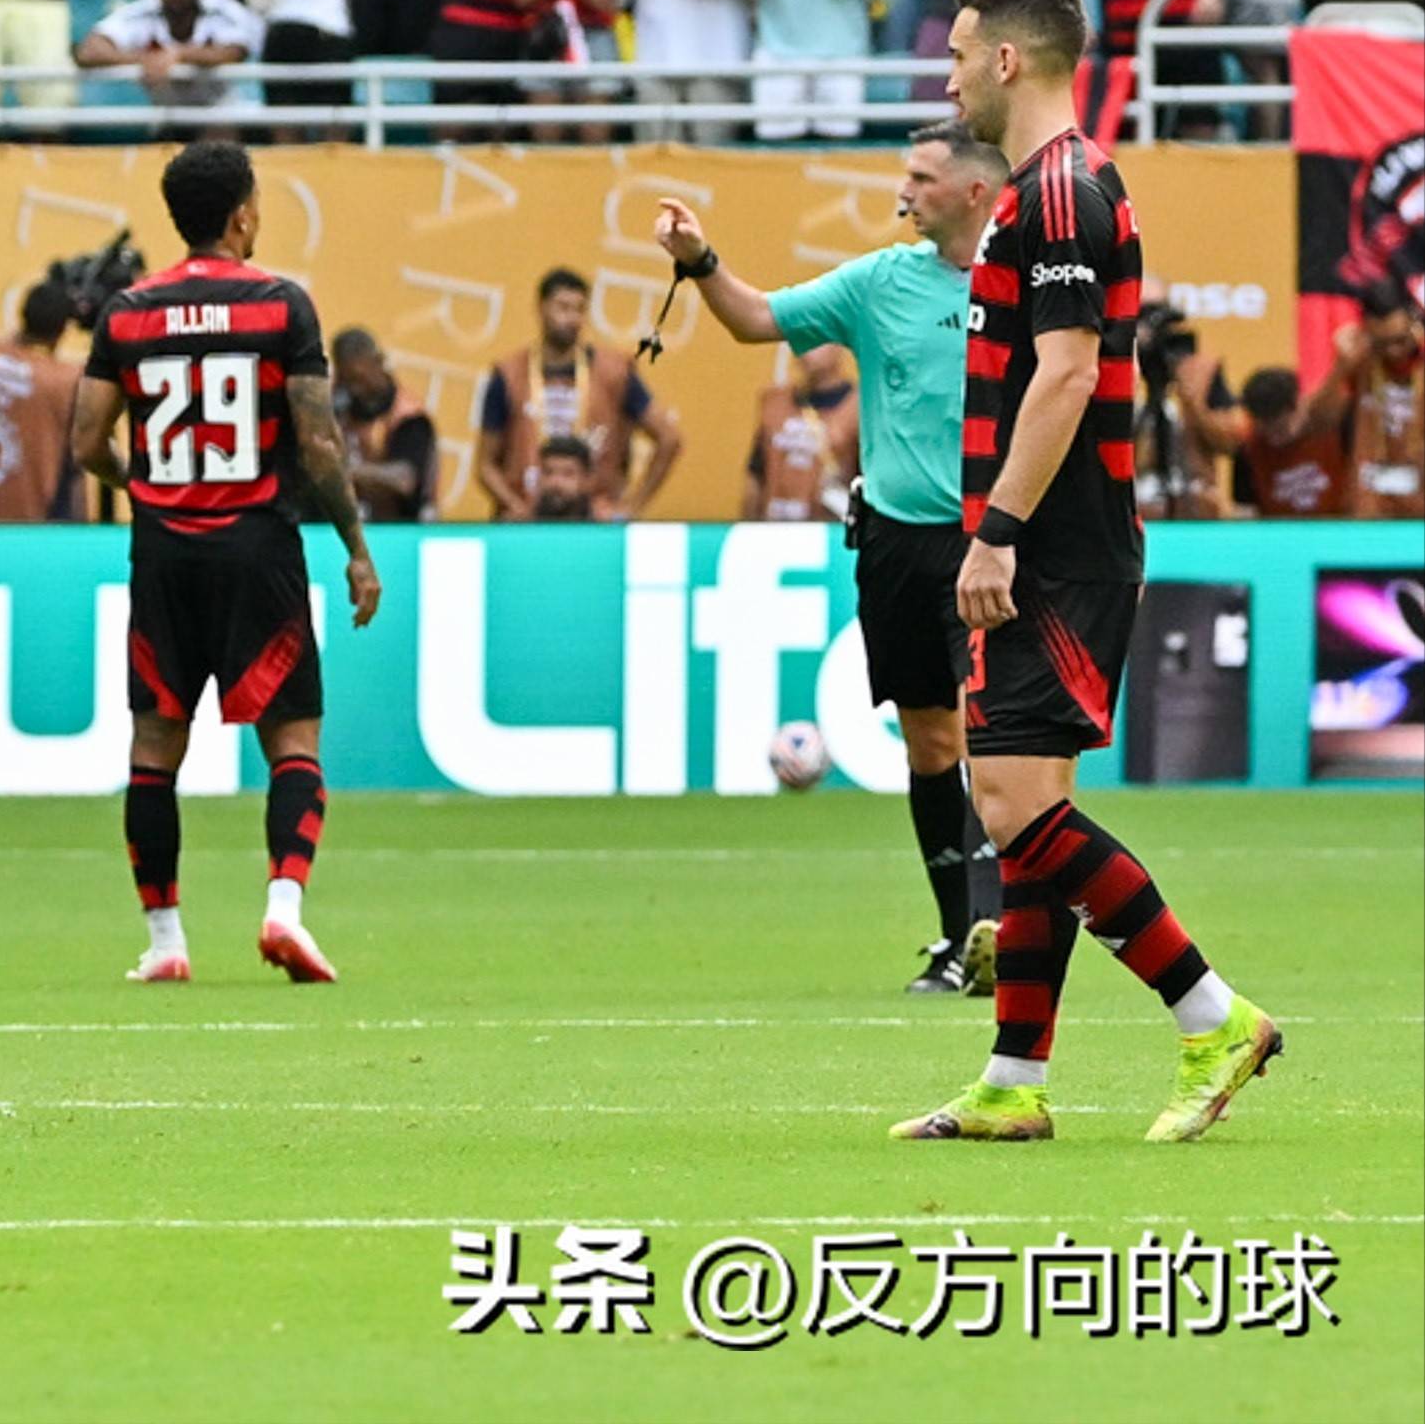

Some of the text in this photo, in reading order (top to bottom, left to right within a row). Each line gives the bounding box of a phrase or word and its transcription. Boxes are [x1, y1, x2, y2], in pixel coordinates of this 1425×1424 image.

[1029, 261, 1096, 288] Shopee
[164, 303, 232, 336] ALLAN
[138, 352, 261, 484] 29
